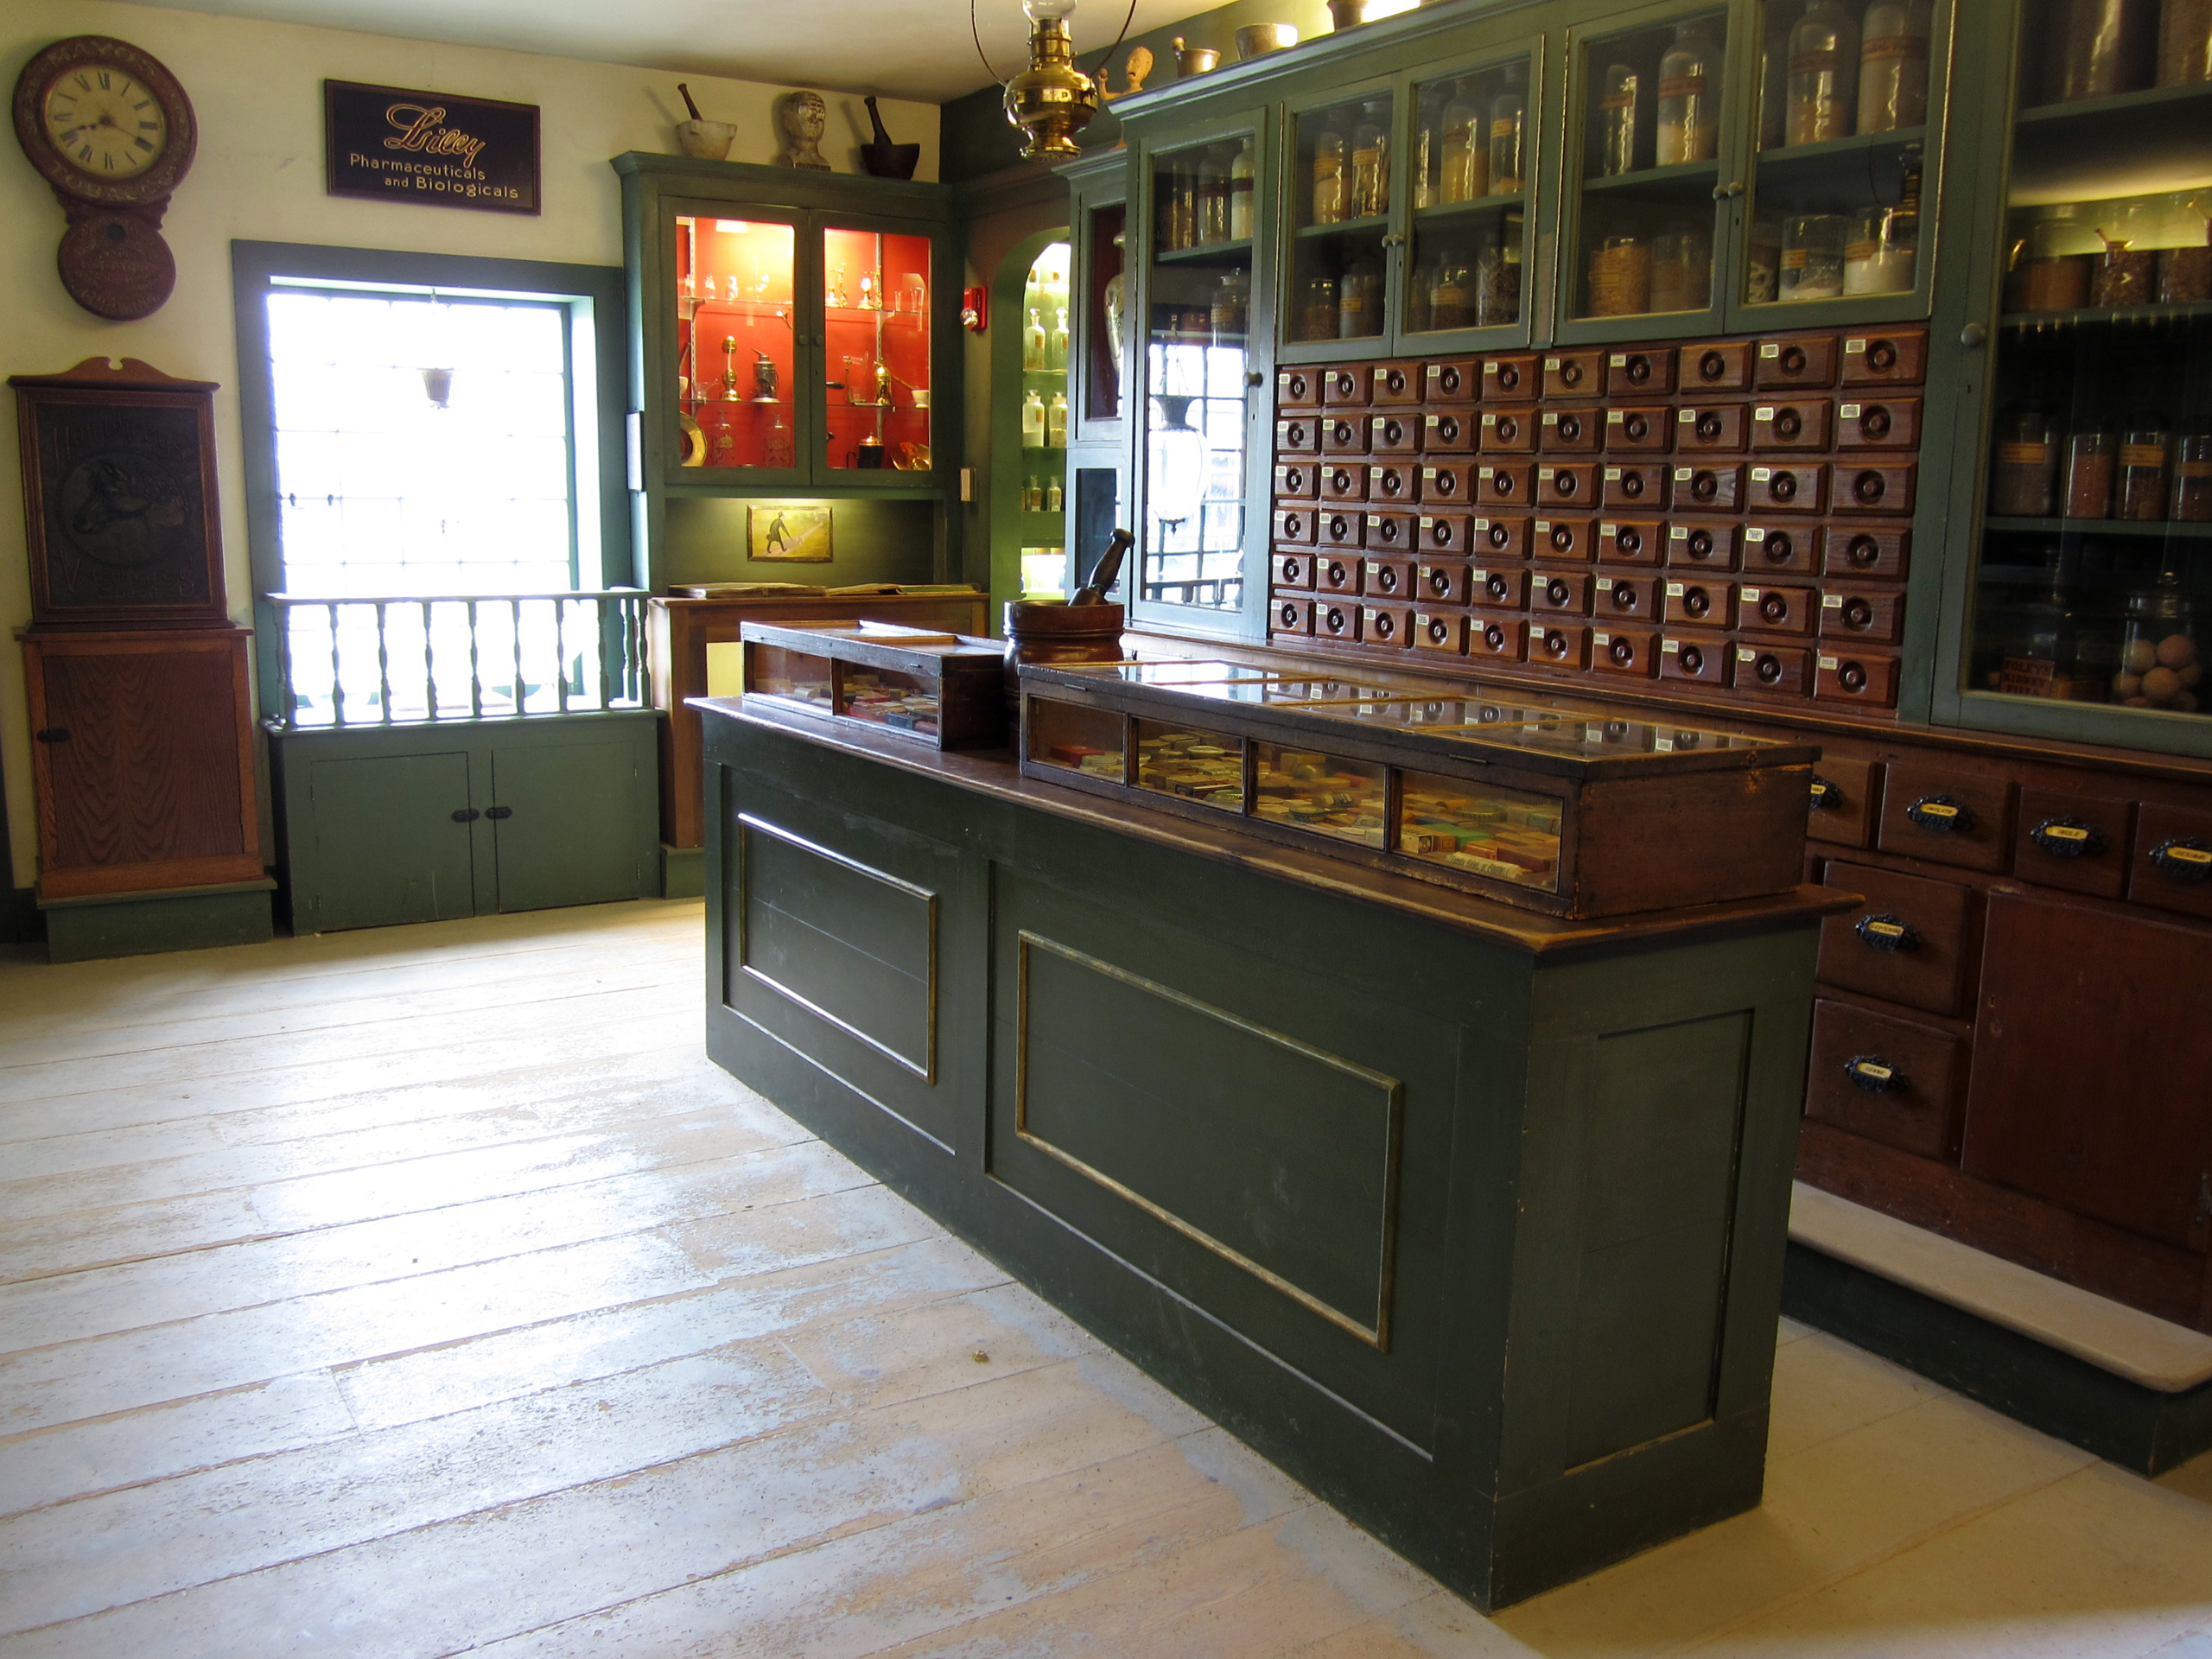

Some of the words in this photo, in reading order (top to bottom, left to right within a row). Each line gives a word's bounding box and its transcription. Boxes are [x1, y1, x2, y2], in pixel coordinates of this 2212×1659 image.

[384, 104, 486, 168] Lilly
[350, 153, 486, 181] Pharmaceuticals
[385, 177, 409, 188] and
[416, 176, 519, 200] Biologicals
[2004, 672, 2046, 688] KIDNEY
